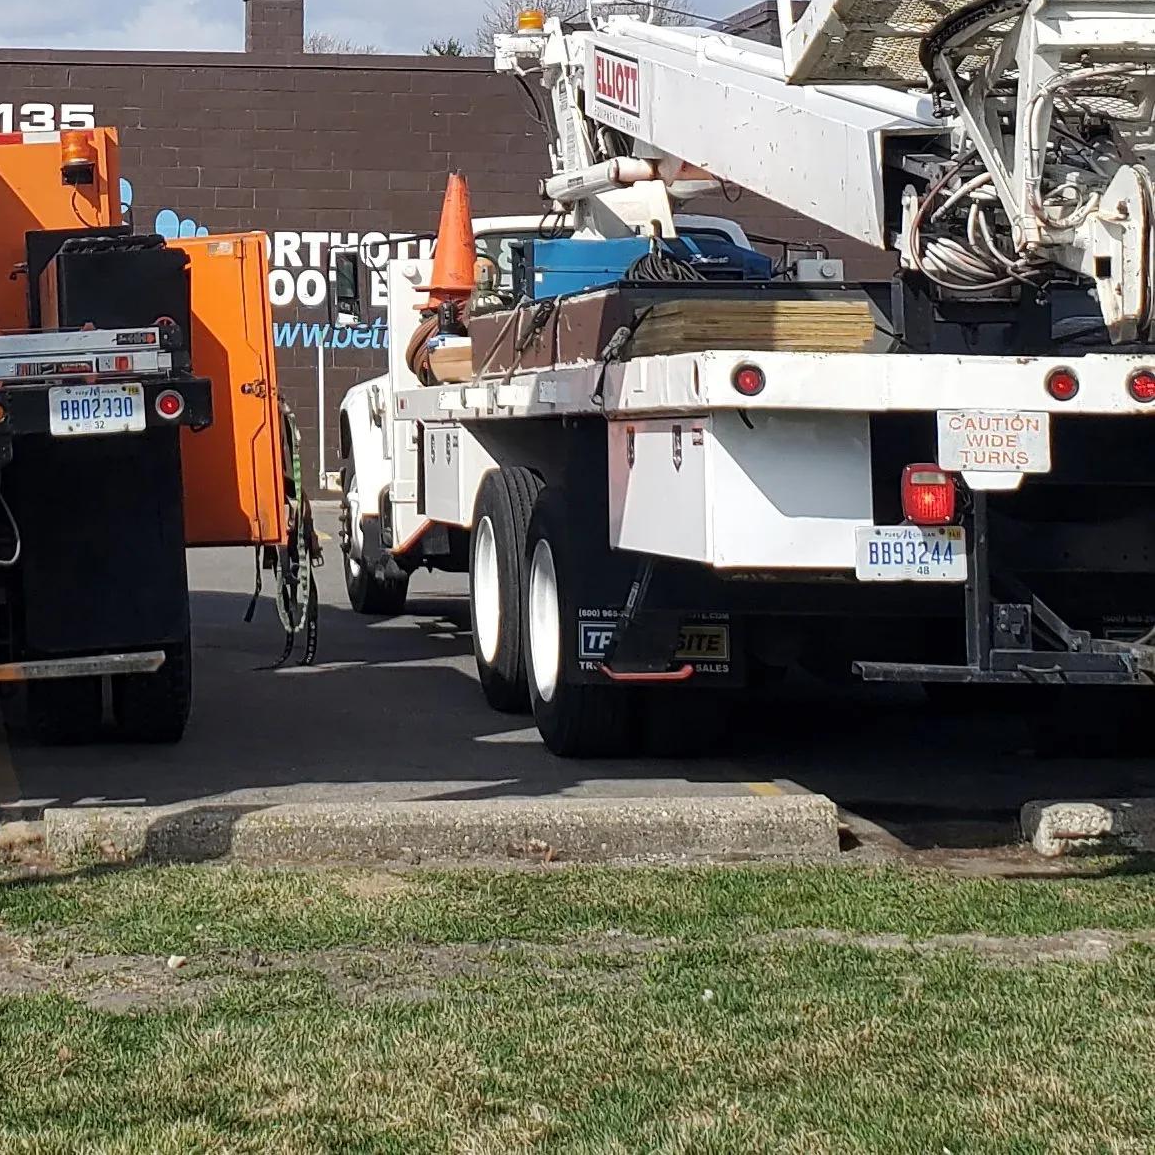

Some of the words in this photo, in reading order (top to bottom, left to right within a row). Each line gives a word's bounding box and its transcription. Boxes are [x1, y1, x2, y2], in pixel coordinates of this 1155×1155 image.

[596, 55, 638, 107] ELLIOTT
[60, 397, 134, 420] BB02330
[94, 420, 105, 429] 32
[949, 416, 1039, 432] CAUTION
[966, 434, 1017, 448] WIDE
[959, 450, 1030, 465] TURNS
[868, 541, 953, 565] BB93244
